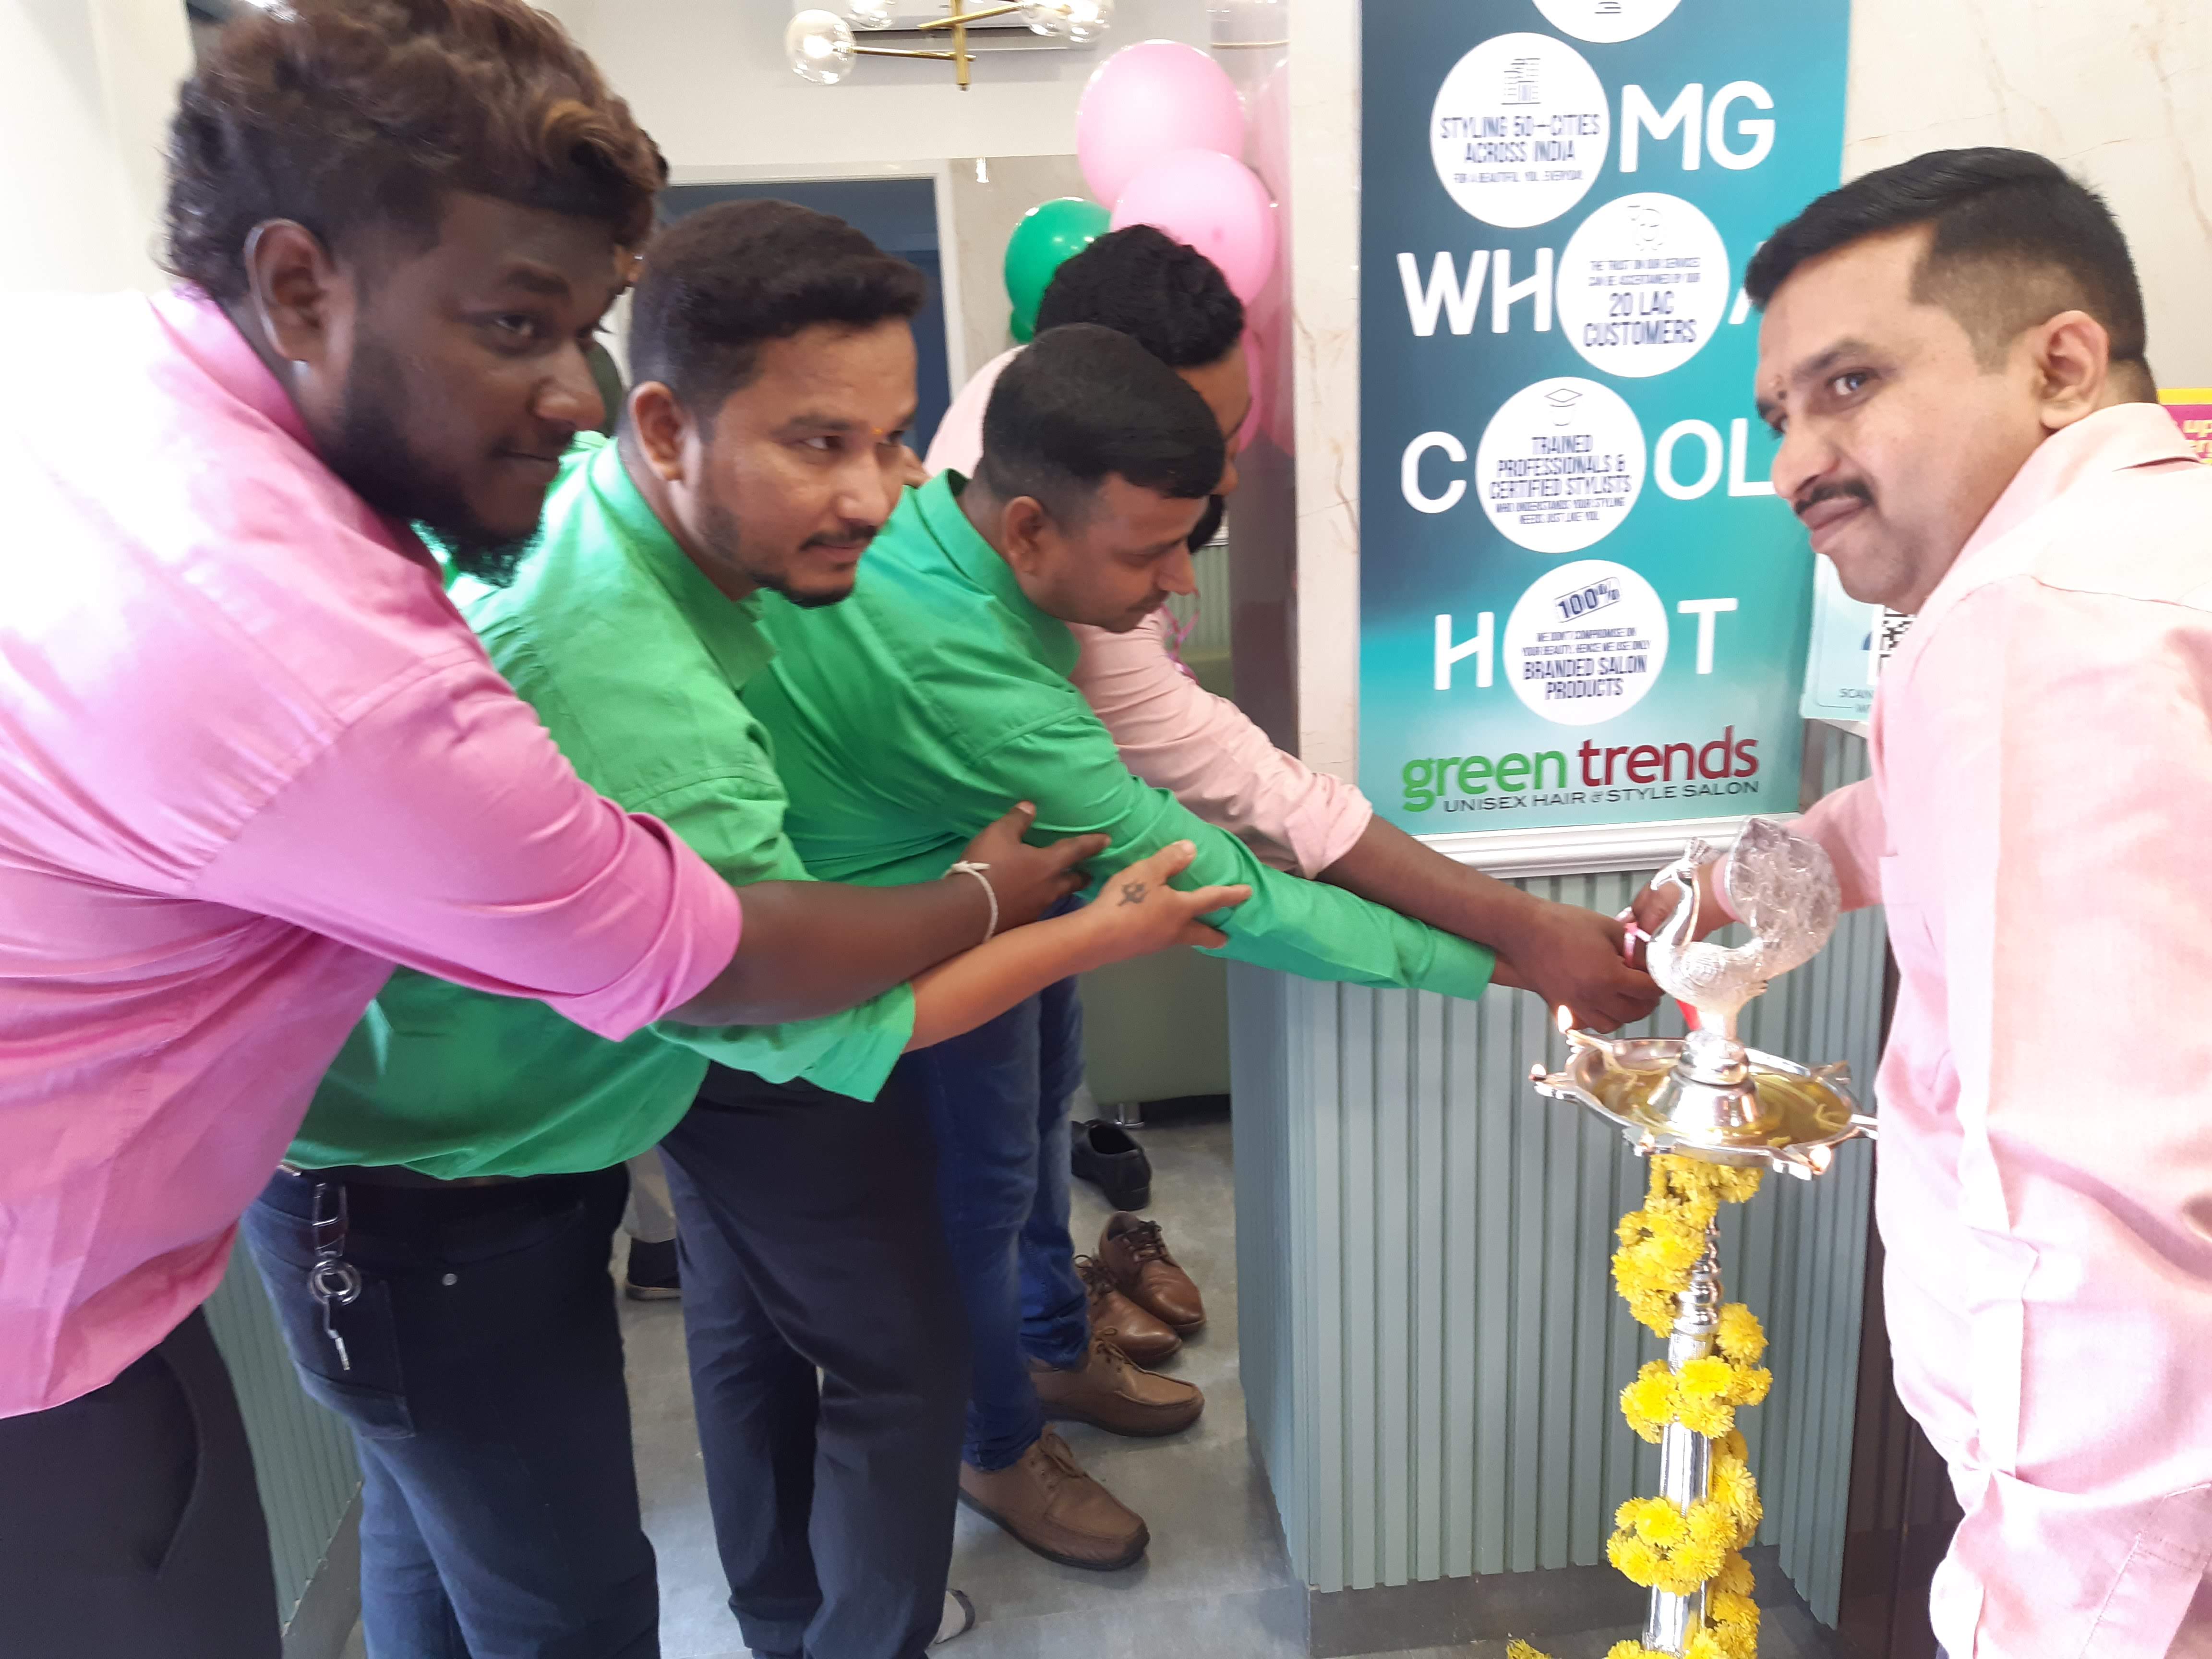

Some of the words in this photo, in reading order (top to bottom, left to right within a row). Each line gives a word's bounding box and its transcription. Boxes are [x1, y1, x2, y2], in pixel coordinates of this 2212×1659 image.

[1442, 117, 1509, 138] STYLING
[1620, 81, 1776, 172] MG
[1465, 142, 1527, 163] ACROSS
[1533, 140, 1575, 162] INDIA
[1609, 292, 1633, 317] 20
[1639, 290, 1674, 316] LAC
[1583, 319, 1697, 347] CUSTOMERS
[1530, 434, 1593, 455] TRAINED
[1496, 456, 1612, 478] PROFESSIONALS
[1615, 454, 1626, 472] &
[1489, 478, 1562, 499] CERTIFIED
[1565, 474, 1632, 495] STYLISTS
[1557, 581, 1621, 618] 100%
[1523, 658, 1595, 680] BRANDED
[1597, 655, 1647, 675] SALON
[1545, 678, 1624, 700] PRODUCTS
[1402, 750, 1568, 812] green
[1577, 725, 1759, 787] trends
[1443, 793, 1527, 812] UNISEX
[1533, 792, 1585, 807] HAIR
[1592, 790, 1601, 803] &
[1604, 786, 1677, 803] STYLE
[1682, 781, 1759, 798] SALON
